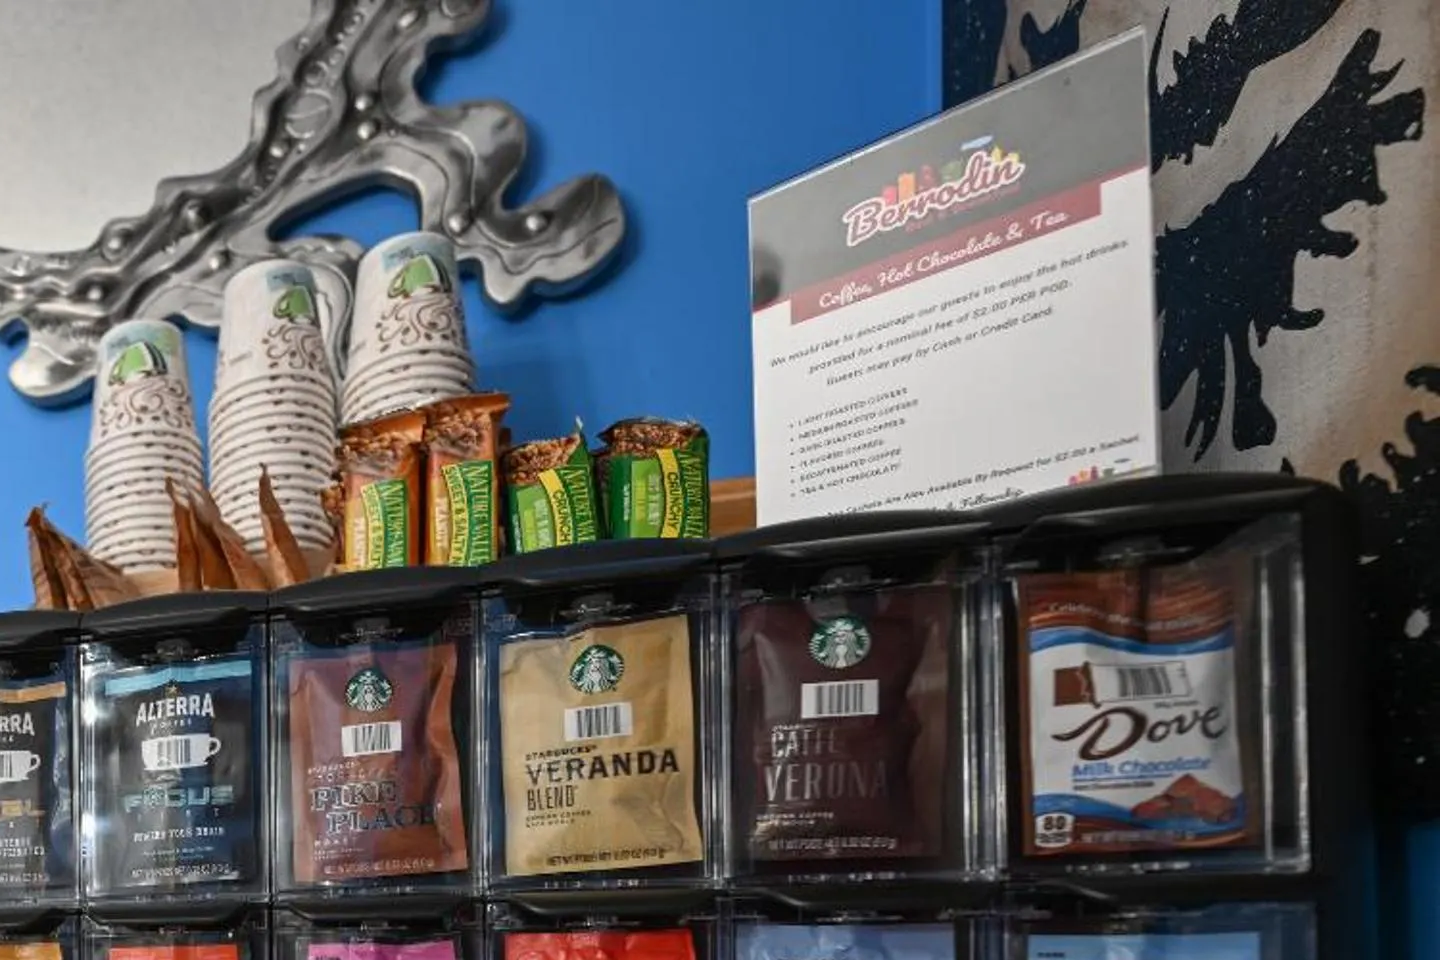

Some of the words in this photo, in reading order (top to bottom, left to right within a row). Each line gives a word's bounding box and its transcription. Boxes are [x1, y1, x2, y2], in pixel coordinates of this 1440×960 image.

[842, 150, 1026, 247] Berrodin
[877, 262, 914, 287] Hot
[917, 232, 1003, 272] Chocolate
[1005, 222, 1024, 241] &
[1030, 210, 1069, 231] Tea
[857, 312, 916, 338] encourage
[1036, 262, 1058, 278] the
[1061, 254, 1084, 269] hot
[552, 489, 572, 546] CRUNCH
[667, 471, 682, 531] CRUNCHY
[136, 693, 215, 727] ALTERRA
[526, 748, 680, 786] VERANDA
[765, 760, 888, 802] VERONA
[1072, 761, 1113, 777] Milk
[1118, 757, 1212, 776] Chocolate
[309, 780, 397, 812] PIKE
[527, 785, 576, 812] BLEND
